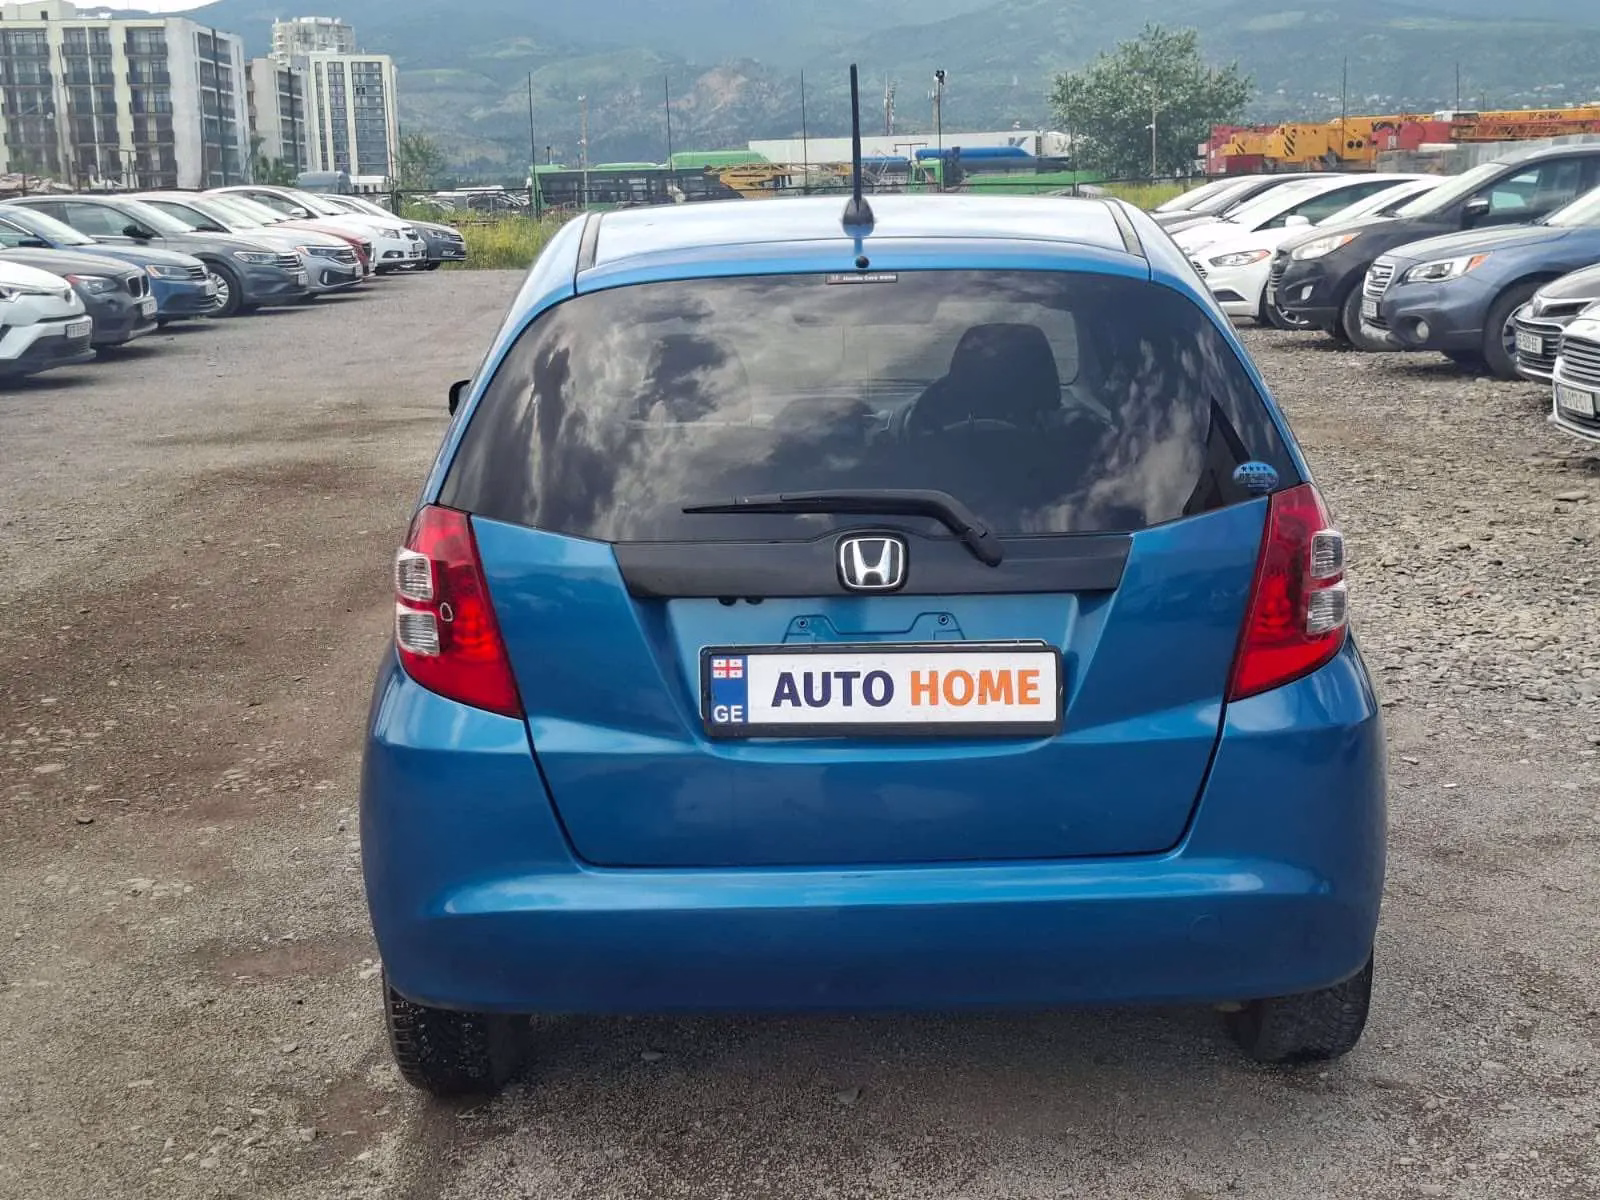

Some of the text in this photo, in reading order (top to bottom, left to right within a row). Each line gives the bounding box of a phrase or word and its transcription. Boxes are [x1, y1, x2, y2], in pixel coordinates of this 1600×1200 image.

[770, 669, 1041, 707] AUTO HOME
[713, 705, 744, 723] GE
